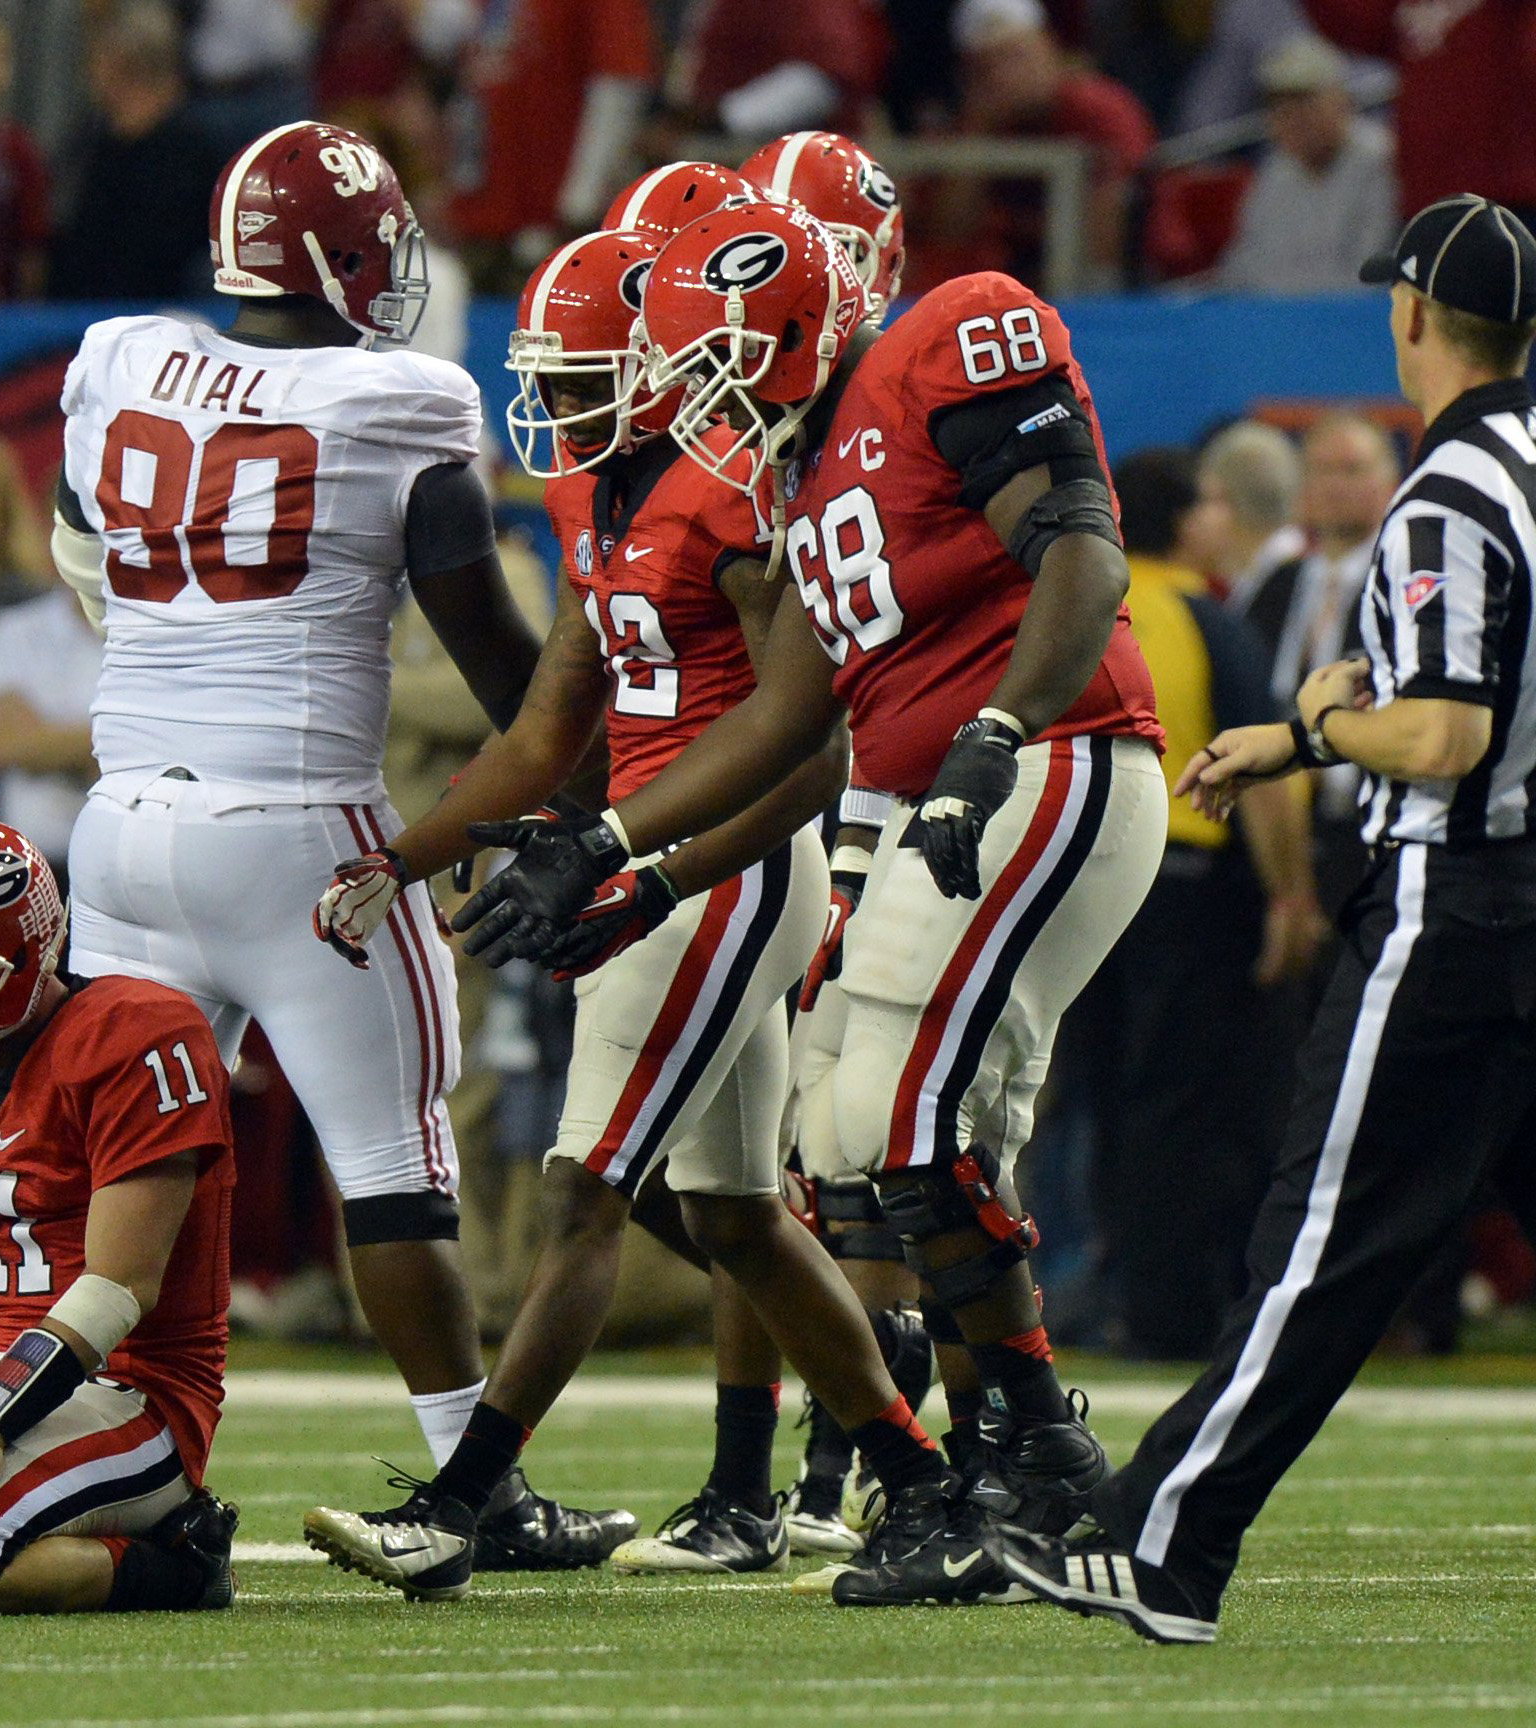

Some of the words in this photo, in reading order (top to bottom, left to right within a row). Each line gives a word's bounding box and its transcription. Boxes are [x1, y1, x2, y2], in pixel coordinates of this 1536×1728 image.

[700, 231, 789, 297] G
[956, 306, 1048, 384] 68
[150, 350, 267, 418] DIAL
[859, 427, 886, 472] C
[95, 409, 320, 604] 90
[786, 485, 905, 667] 68
[583, 588, 681, 719] 12
[143, 1041, 208, 1115] 11
